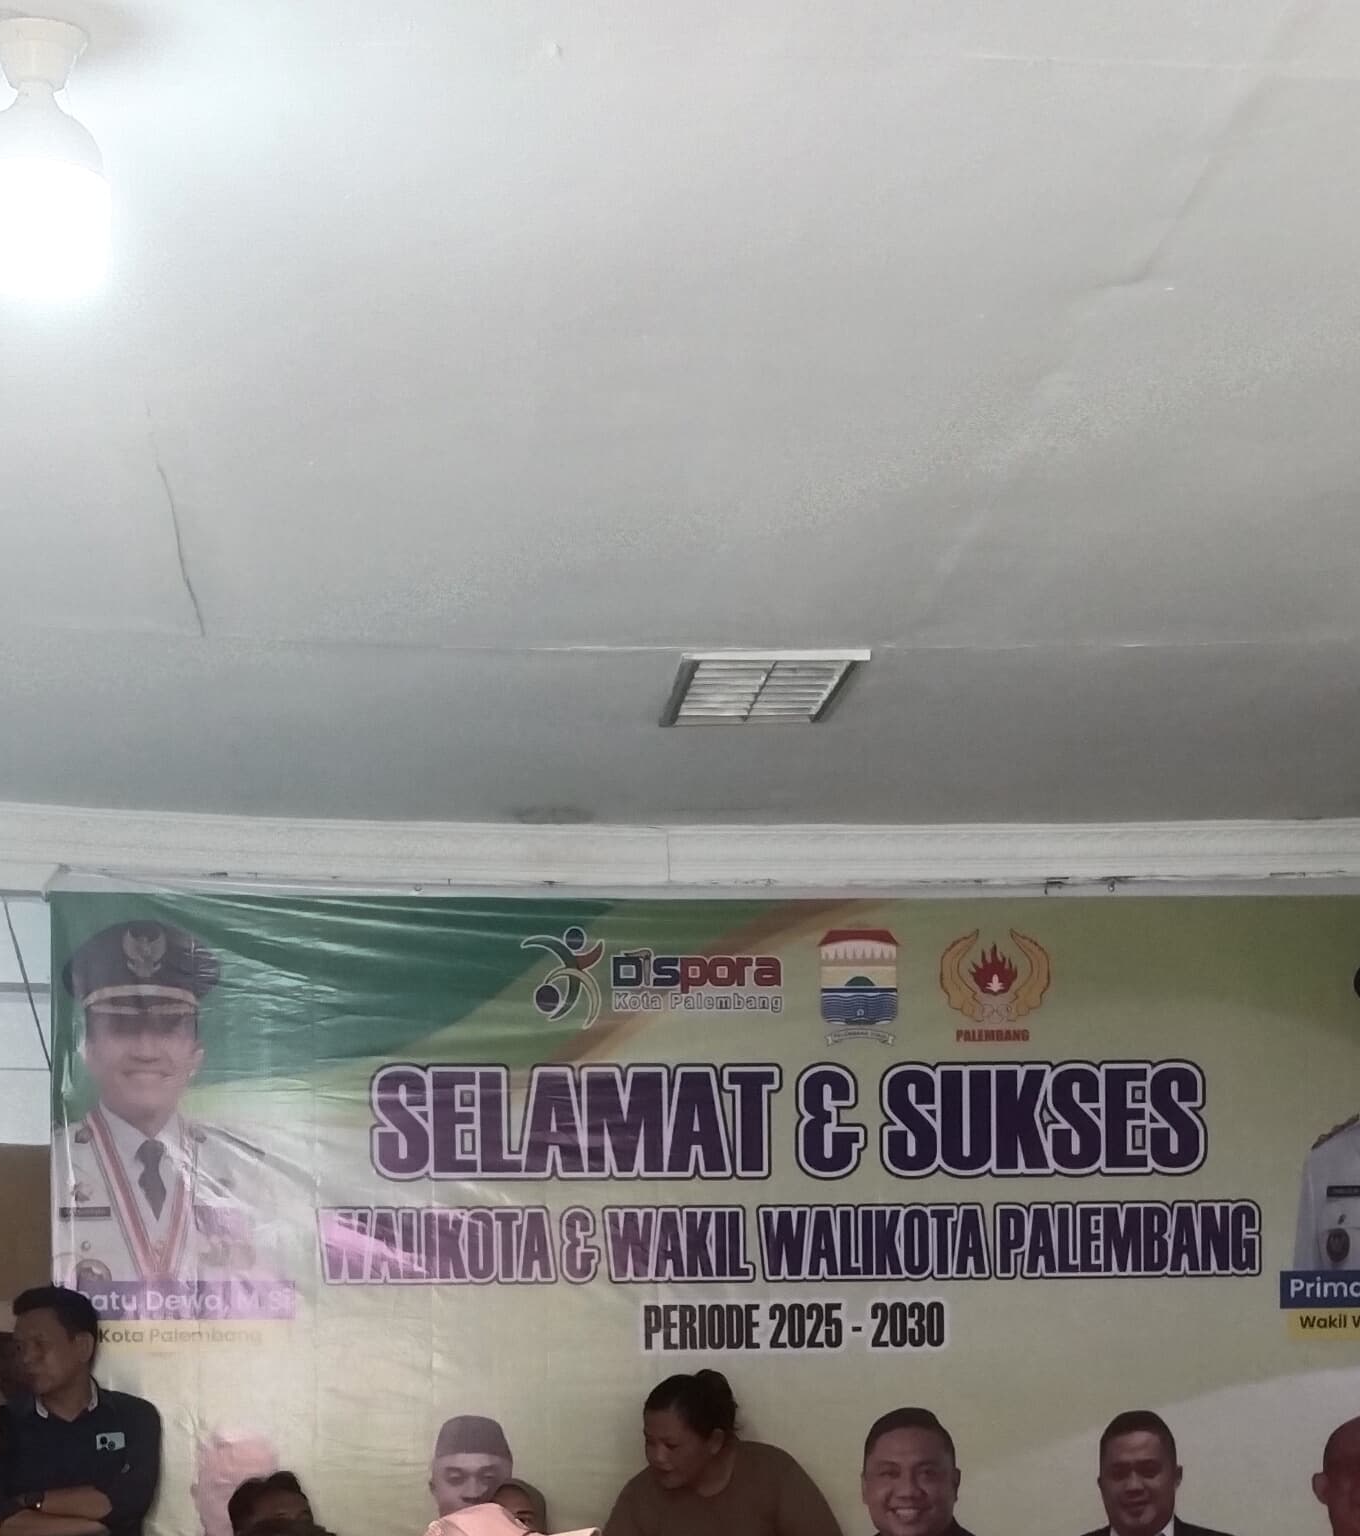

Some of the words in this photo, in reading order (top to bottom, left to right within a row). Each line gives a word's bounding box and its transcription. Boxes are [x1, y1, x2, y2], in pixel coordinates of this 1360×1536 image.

[614, 992, 662, 1010] Kota
[670, 993, 784, 1013] Palembang
[955, 1029, 1030, 1042] PALEMBANG
[371, 1063, 783, 1179] SELAMAT
[796, 1062, 867, 1179] &
[880, 1060, 1207, 1178] SUKSES
[317, 1207, 557, 1284] WALIKOTA
[560, 1207, 600, 1284] &
[603, 1206, 755, 1283] WAKIL
[757, 1203, 990, 1281] WALIKOTA
[994, 1200, 1262, 1279] PALEMBANG
[78, 1290, 137, 1312] atu
[644, 1304, 760, 1350] PERIODE
[769, 1303, 842, 1349] 2025
[871, 1301, 945, 1347] 2030
[1300, 1313, 1347, 1329] Wakil
[99, 1327, 143, 1343] Kota
[150, 1327, 262, 1346] Palembang
